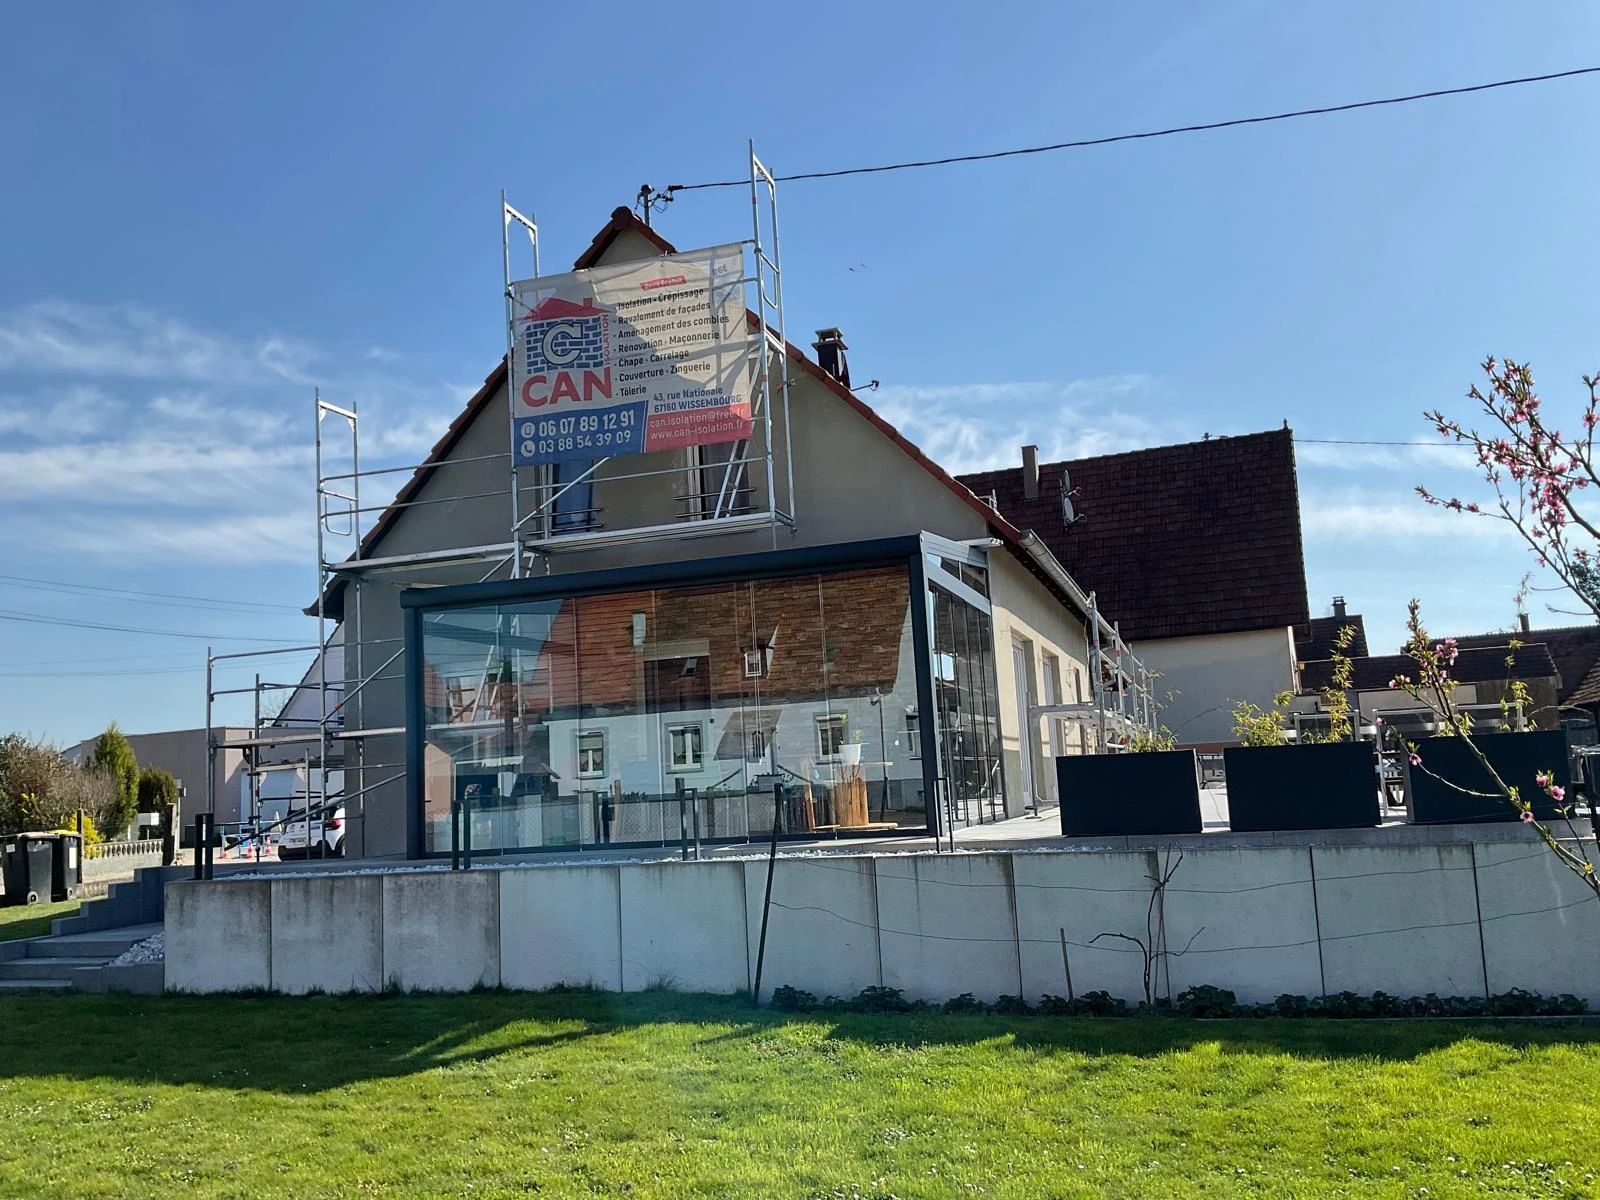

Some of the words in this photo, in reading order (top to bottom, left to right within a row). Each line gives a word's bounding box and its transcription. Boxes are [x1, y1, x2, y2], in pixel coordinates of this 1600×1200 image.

[618, 296, 652, 310] Isolation
[658, 288, 704, 303] Crépissage
[618, 310, 665, 325] Ravalement
[666, 306, 677, 315] de
[678, 301, 711, 315] façades
[677, 318, 692, 328] des
[693, 314, 730, 326] combles
[541, 322, 583, 365] C
[618, 339, 663, 353] Rénovation
[669, 330, 720, 345] Maçonnerie
[618, 357, 643, 369] Chape
[650, 349, 690, 363] Carrelage
[619, 368, 664, 382] Couverture
[670, 361, 711, 375] Zinguerie
[521, 366, 612, 408] CAN
[620, 385, 647, 397] Tôlerie
[653, 393, 665, 403] 43,
[667, 392, 681, 400] rue
[683, 386, 723, 398] Nationale
[654, 402, 676, 413] 67160
[678, 394, 742, 411] WISSEMBOURG
[539, 420, 556, 437] 06
[559, 417, 575, 434] 07
[579, 414, 598, 432] 89
[602, 412, 617, 428] 12
[620, 409, 635, 427] 91
[649, 407, 745, 428] can.isolation@free.fr
[650, 420, 743, 440] www.can-isolation.fr
[539, 441, 554, 453] 03
[558, 438, 573, 451] 88
[577, 435, 592, 448] 54
[595, 432, 611, 446] 39
[616, 429, 631, 444] 09
